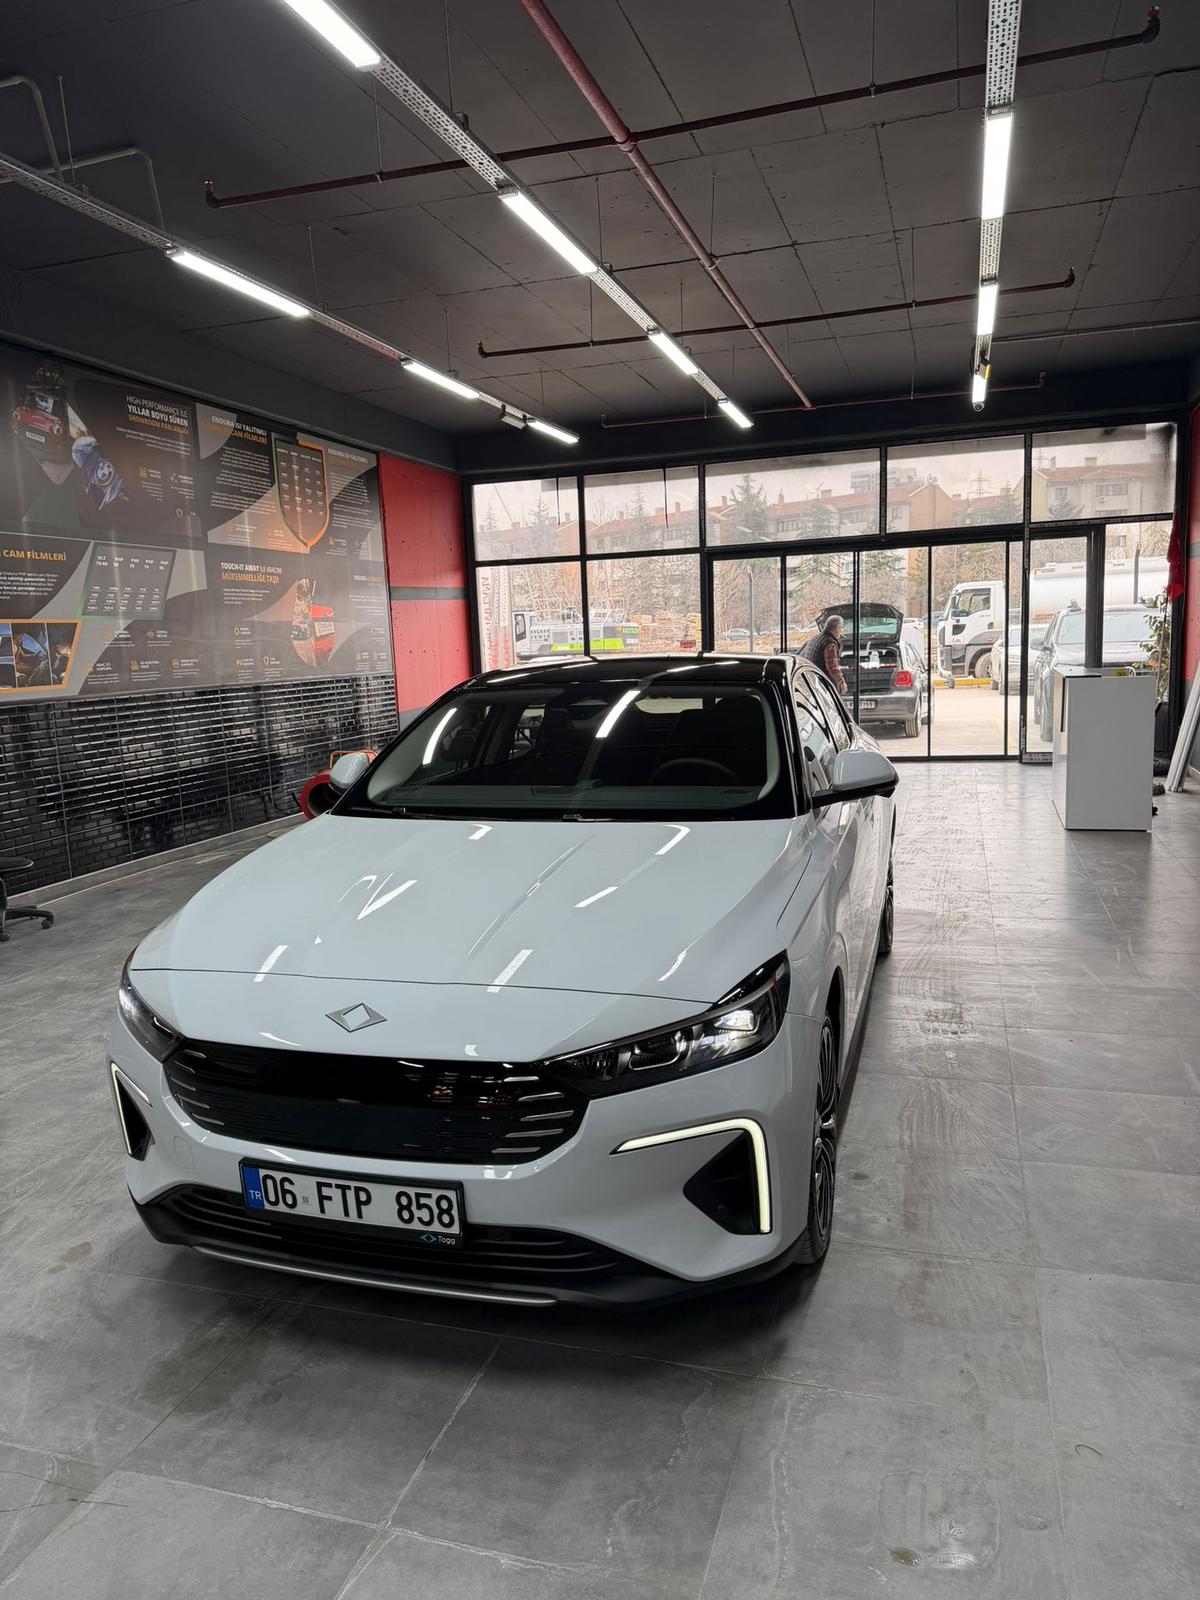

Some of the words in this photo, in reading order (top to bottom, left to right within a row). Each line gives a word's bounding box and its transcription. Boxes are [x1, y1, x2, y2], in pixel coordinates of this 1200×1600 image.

[128, 404, 150, 417] YILLAR
[151, 410, 168, 421] BOYU
[169, 414, 189, 427] SÜREN
[3, 549, 25, 559] CAM
[27, 549, 67, 562] FİLMLERİ
[249, 1189, 262, 1201] TR
[261, 1174, 298, 1209] 06
[315, 1181, 372, 1219] FTP
[395, 1190, 455, 1229] 858
[437, 1235, 455, 1246] Togg
